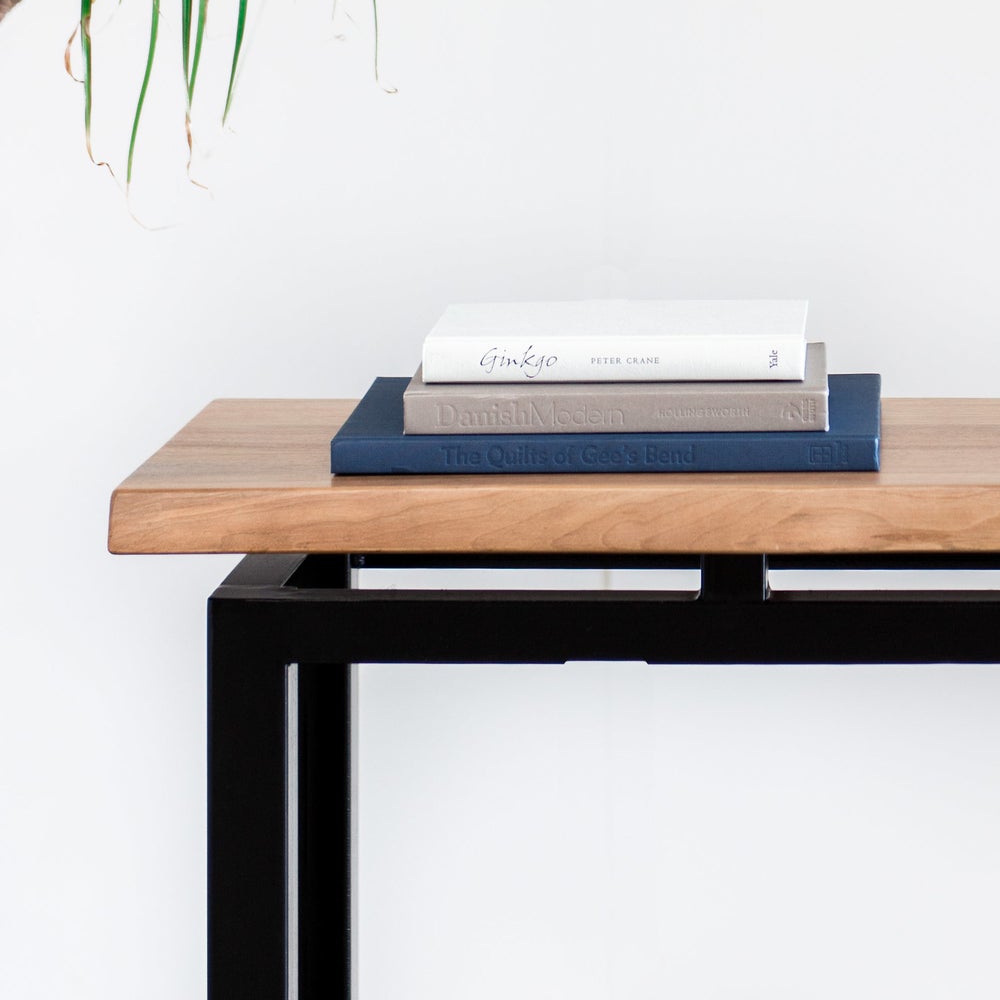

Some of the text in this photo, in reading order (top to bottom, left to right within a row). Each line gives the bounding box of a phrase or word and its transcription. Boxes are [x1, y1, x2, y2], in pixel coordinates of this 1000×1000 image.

[480, 345, 558, 378] Ginkgo
[590, 357, 660, 365] PETER CRANE
[769, 349, 778, 369] Yale
[441, 446, 480, 466] The
[486, 446, 547, 468] Quilts
[552, 445, 575, 465] of
[644, 444, 696, 466] Bend
